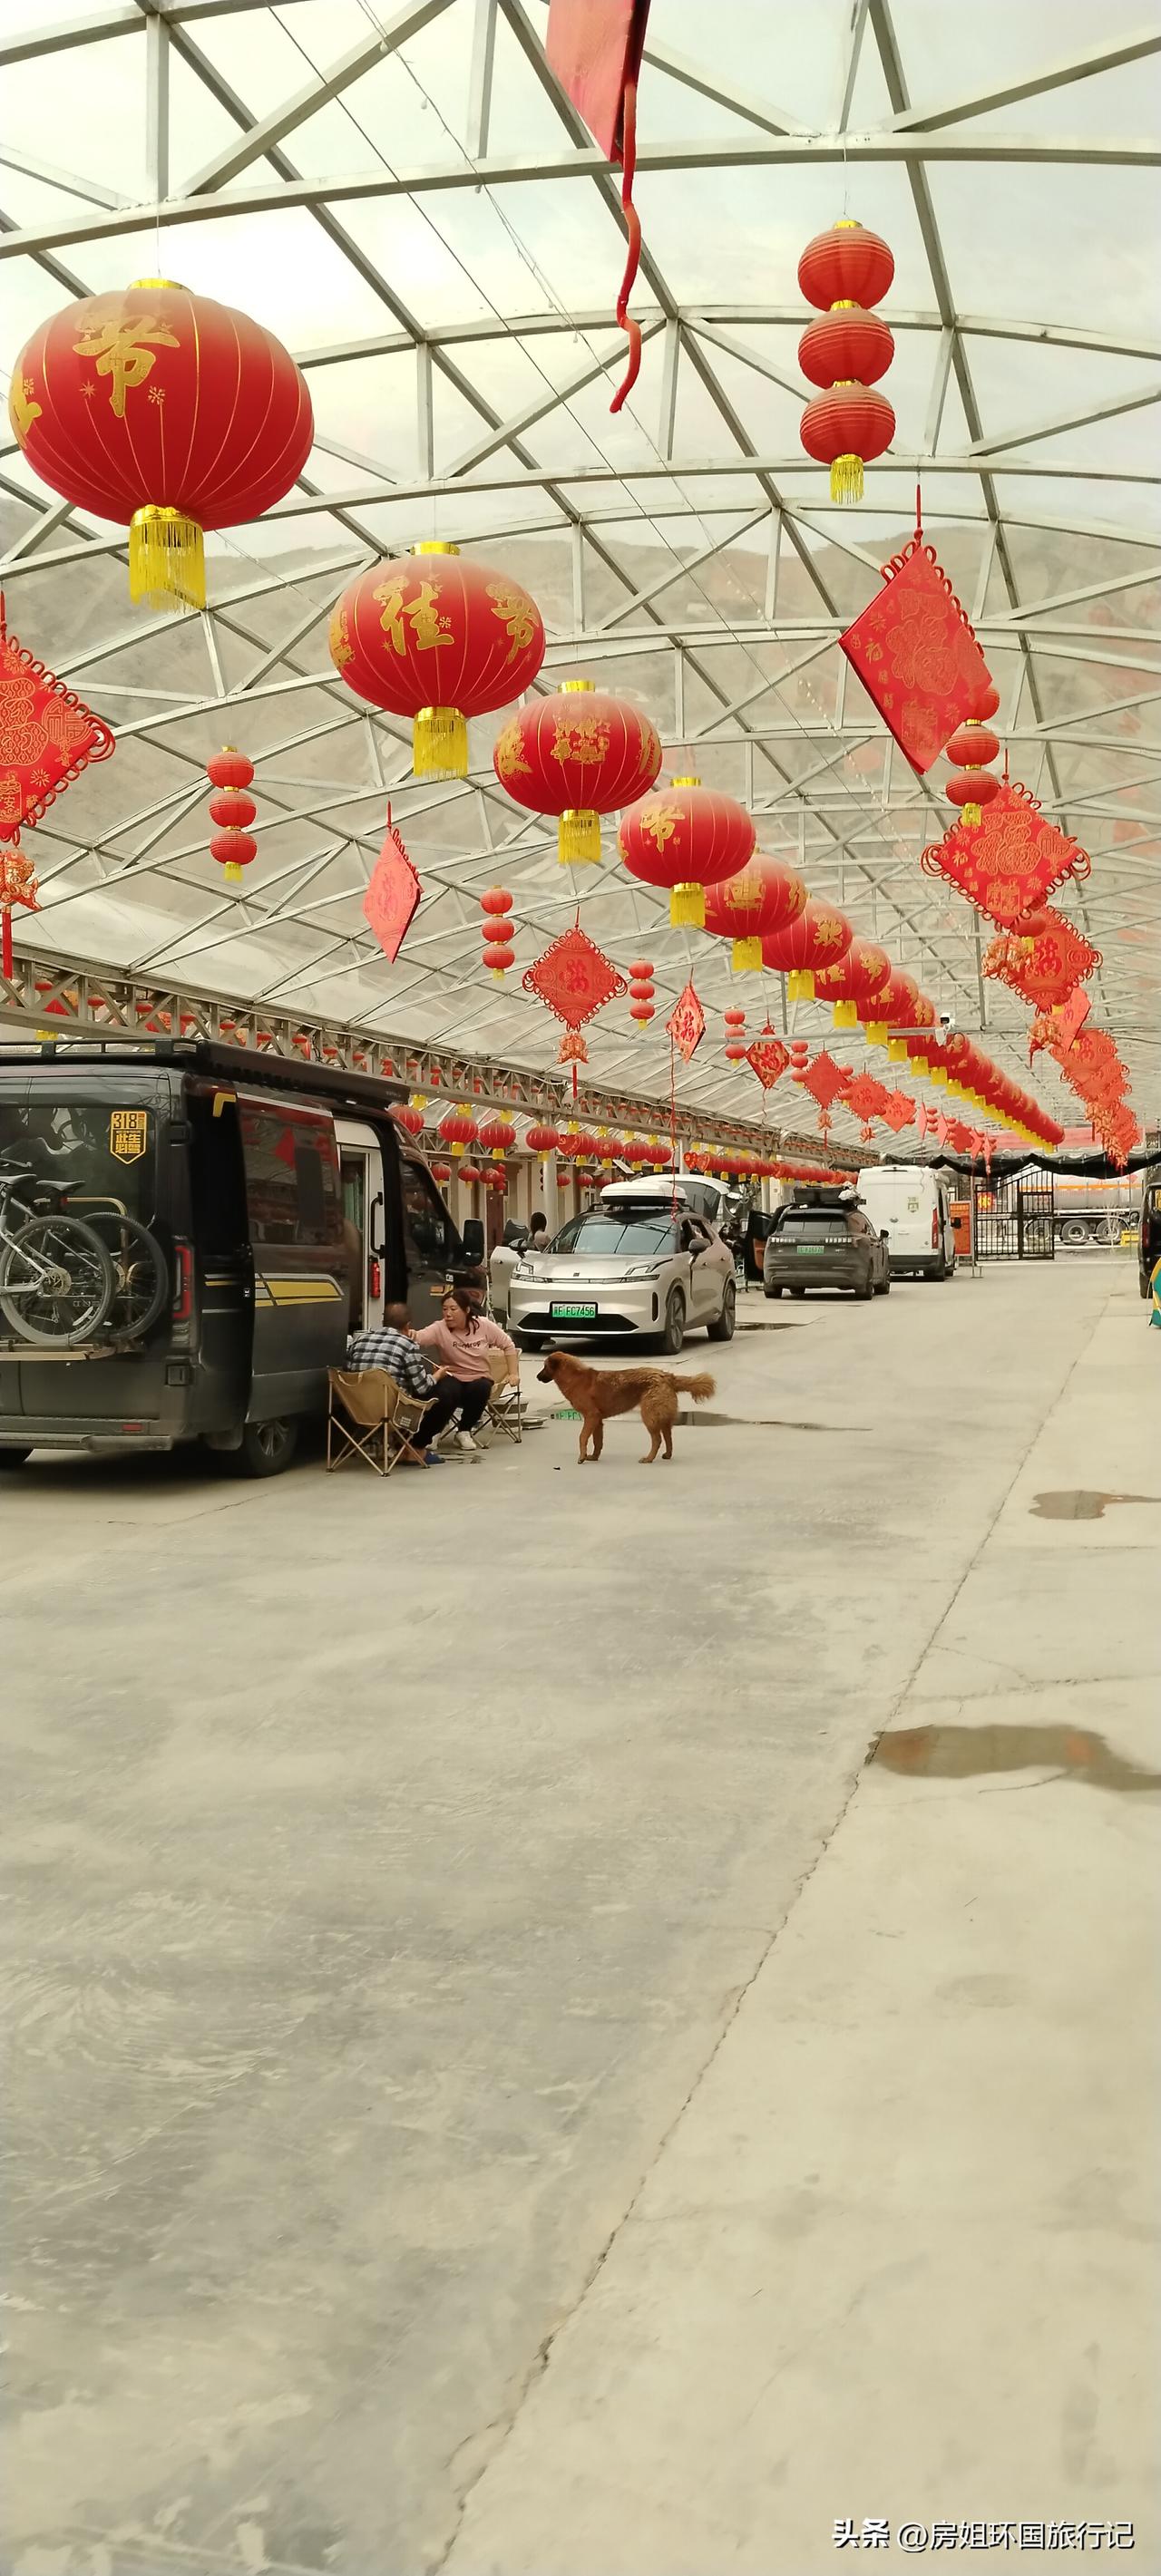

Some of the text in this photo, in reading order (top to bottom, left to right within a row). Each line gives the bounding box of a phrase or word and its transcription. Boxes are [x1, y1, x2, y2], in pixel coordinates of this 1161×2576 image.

[73, 315, 181, 418] 节
[4, 796, 15, 809] 安
[113, 1113, 137, 1128] 318
